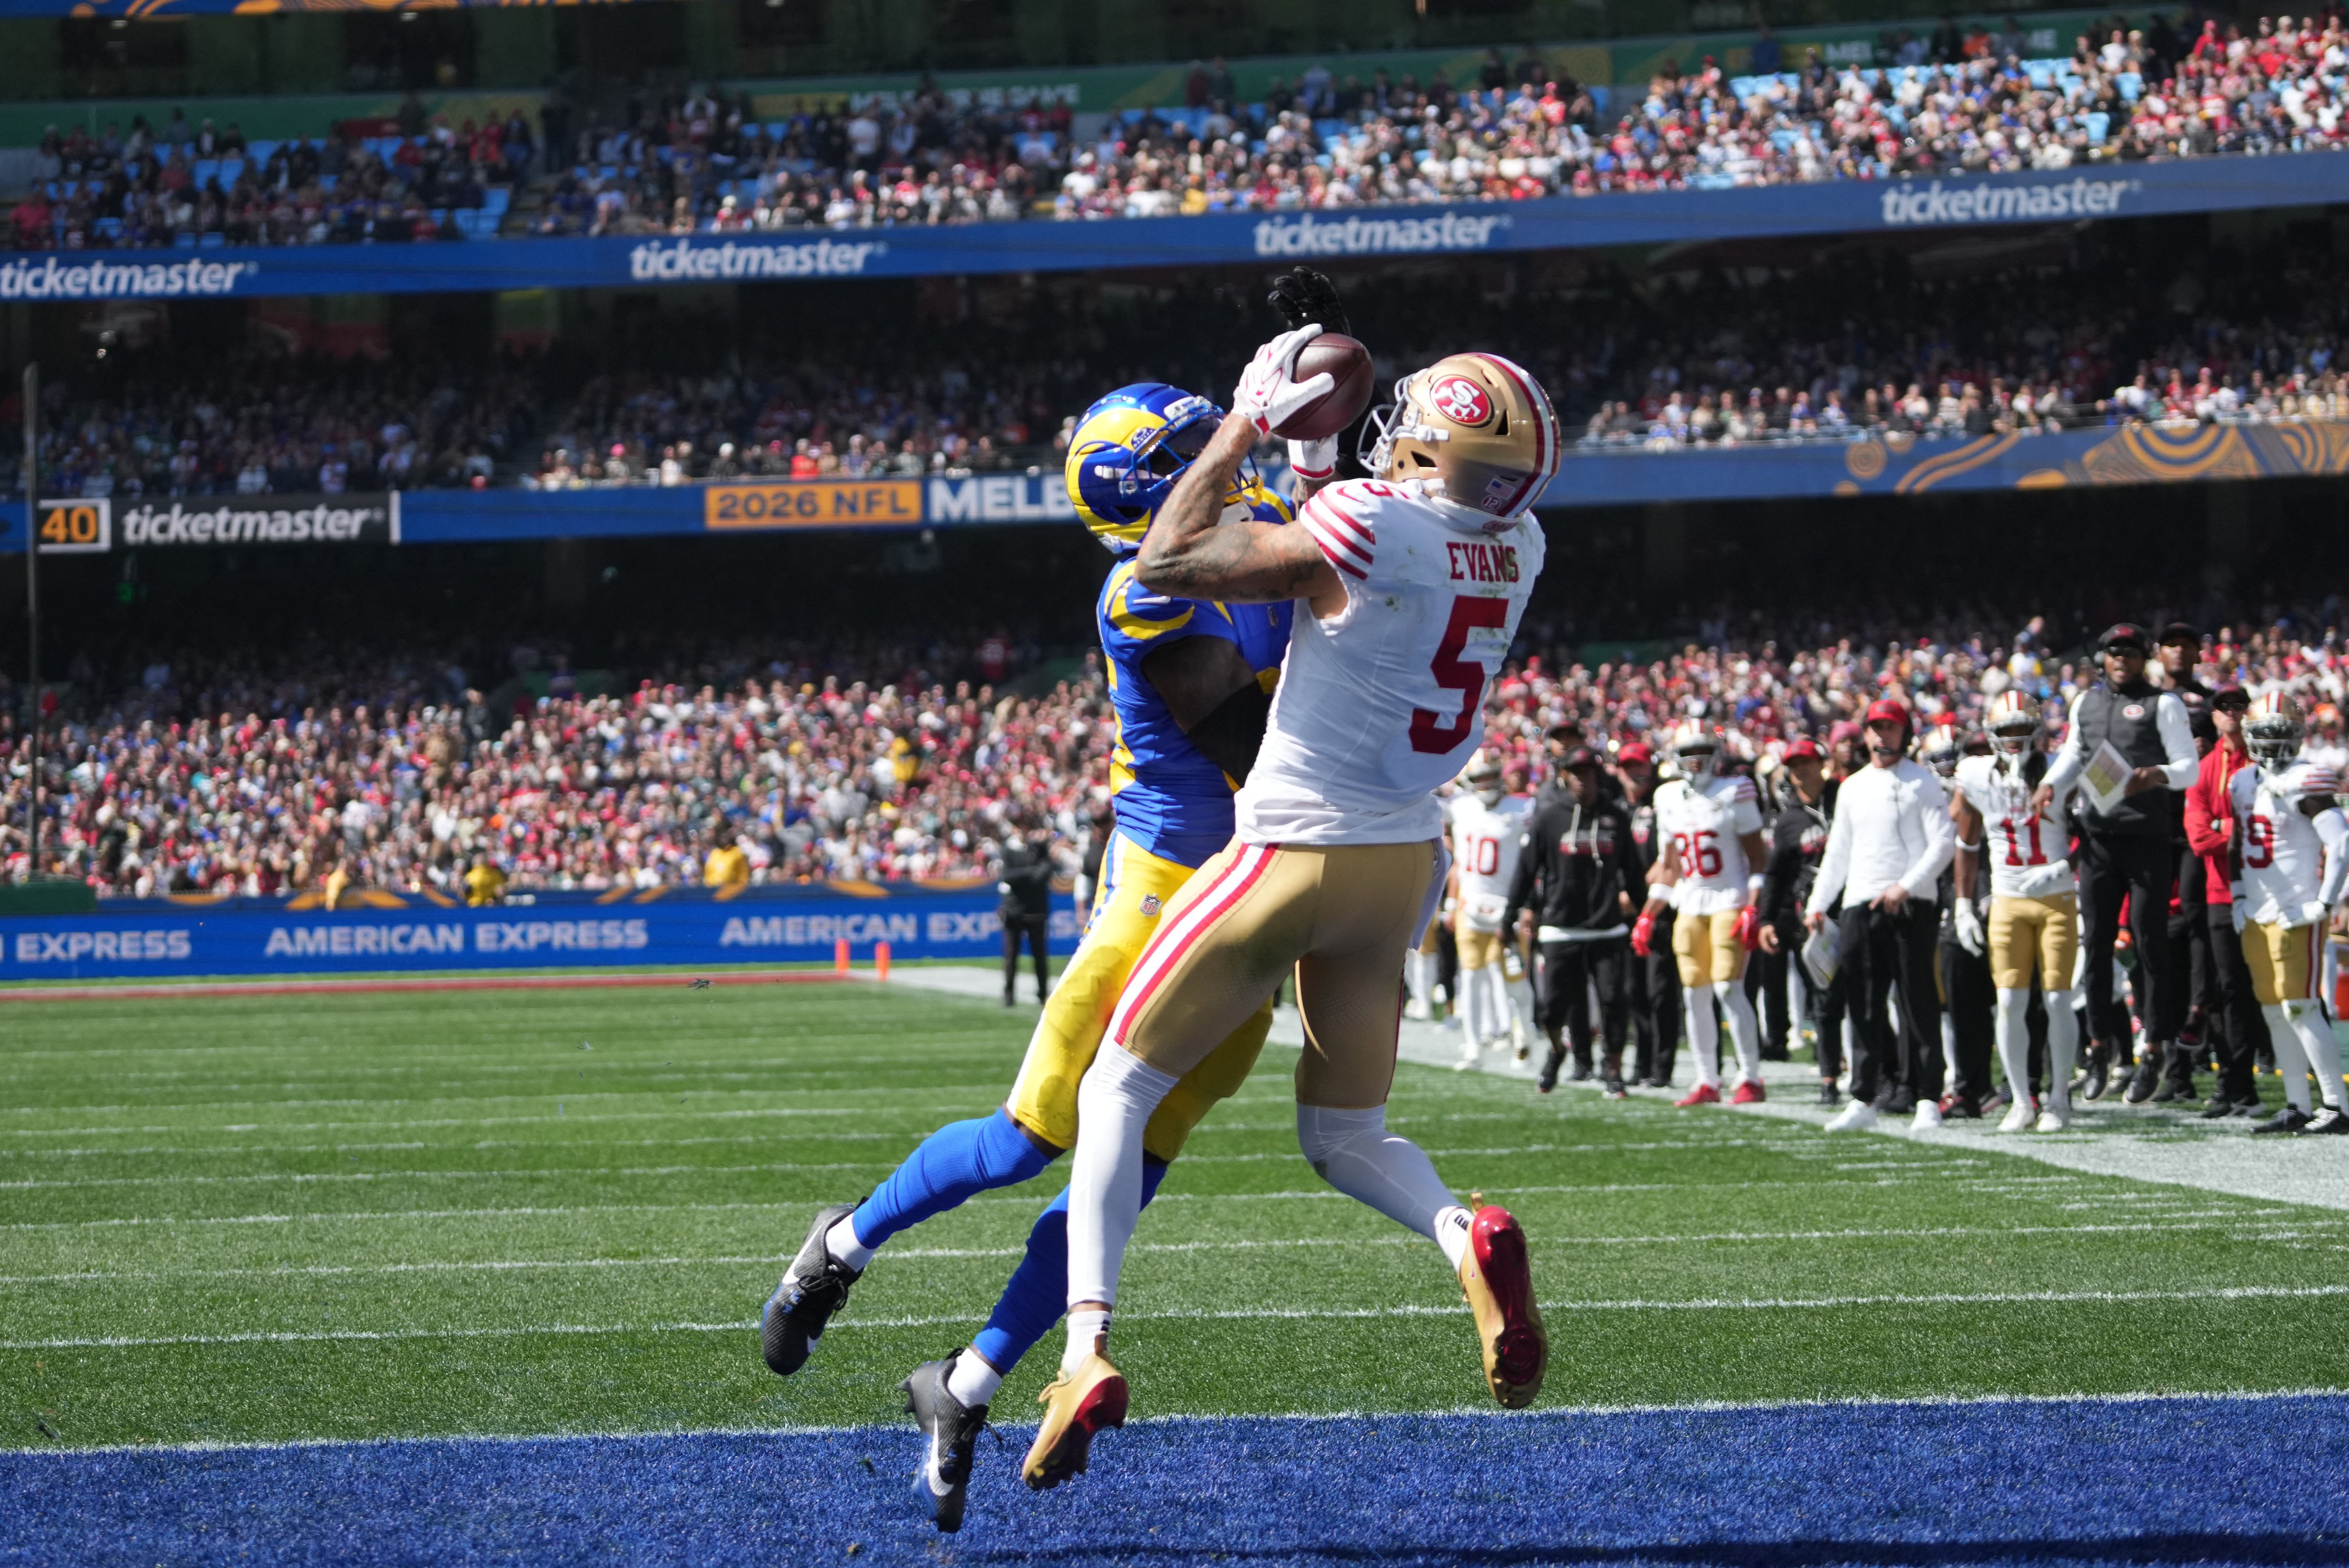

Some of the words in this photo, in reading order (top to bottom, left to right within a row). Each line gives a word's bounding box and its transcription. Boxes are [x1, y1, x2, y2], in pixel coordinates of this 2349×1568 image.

[1881, 180, 2129, 224] ticketmaster
[1254, 214, 1497, 255] ticketmaster
[0, 257, 243, 298] ticketmaster
[630, 239, 873, 279] ticketmaster
[718, 491, 819, 520] 2026
[835, 489, 910, 516] NFL
[929, 476, 1074, 522] MELB
[1483, 497, 1499, 509] 12
[41, 506, 98, 544] 40
[123, 504, 371, 544] ticketmaster
[1446, 542, 1519, 583] EVANS
[1408, 595, 1509, 754] 5
[1466, 835, 1499, 875] 10
[2000, 814, 2048, 866] 11
[2237, 814, 2273, 868] 9
[16, 930, 192, 962] EXPRESS
[264, 924, 463, 957] AMERICAN
[476, 919, 648, 952] EXPRESS
[719, 914, 916, 946] AMERICAN
